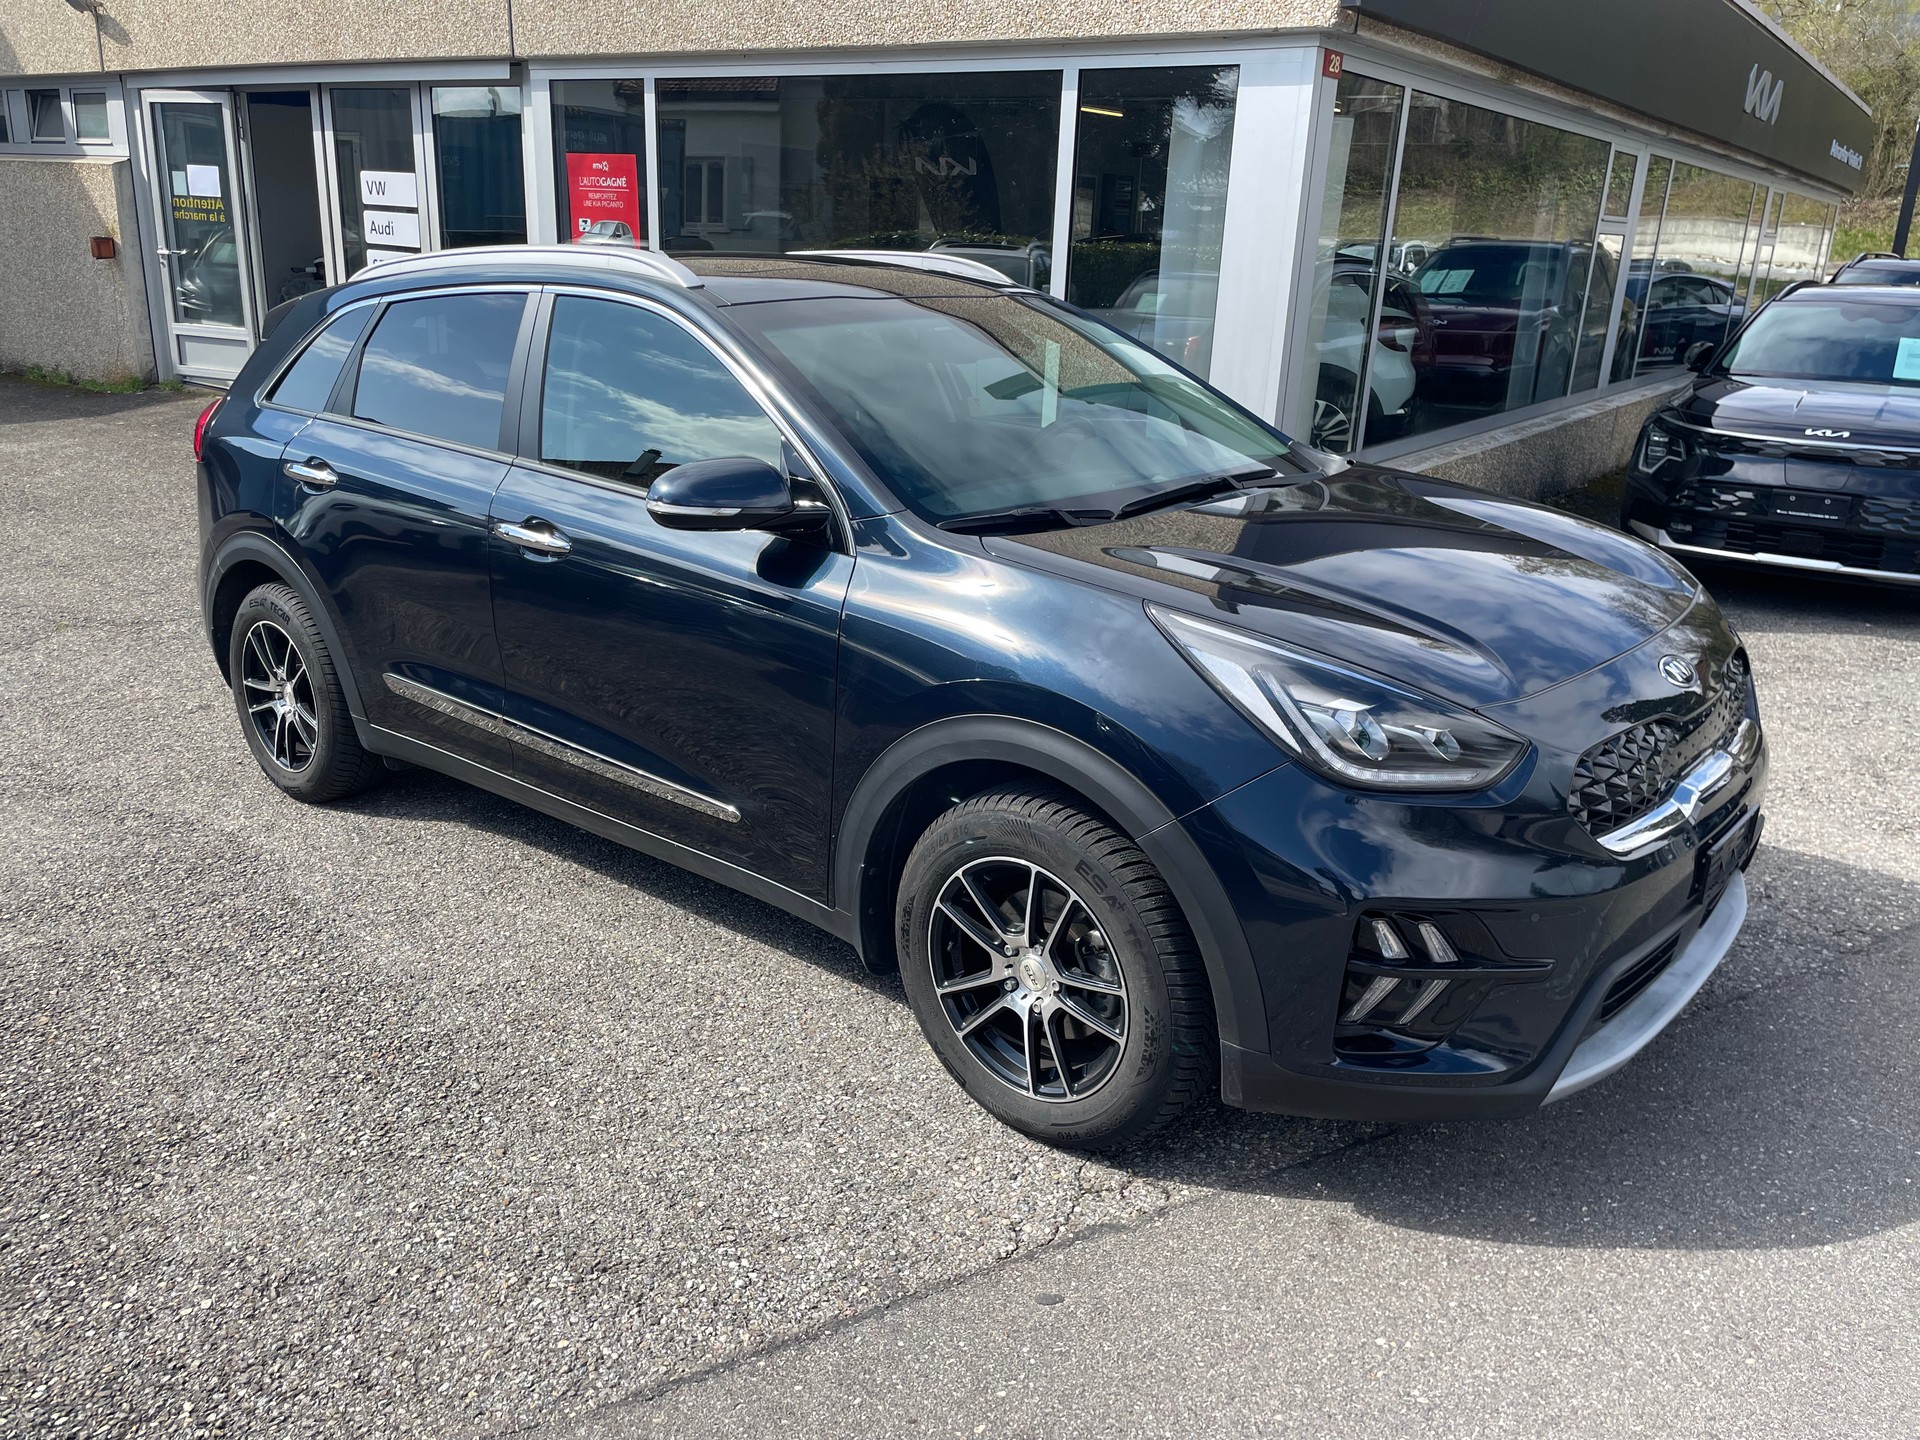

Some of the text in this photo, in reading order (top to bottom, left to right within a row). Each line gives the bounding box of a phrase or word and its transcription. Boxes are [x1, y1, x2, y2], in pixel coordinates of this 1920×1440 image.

[1329, 54, 1341, 73] 28
[366, 180, 386, 196] VW
[588, 193, 617, 201] REMPORTEZ
[370, 220, 394, 236] Audi
[270, 601, 291, 626] TECAR
